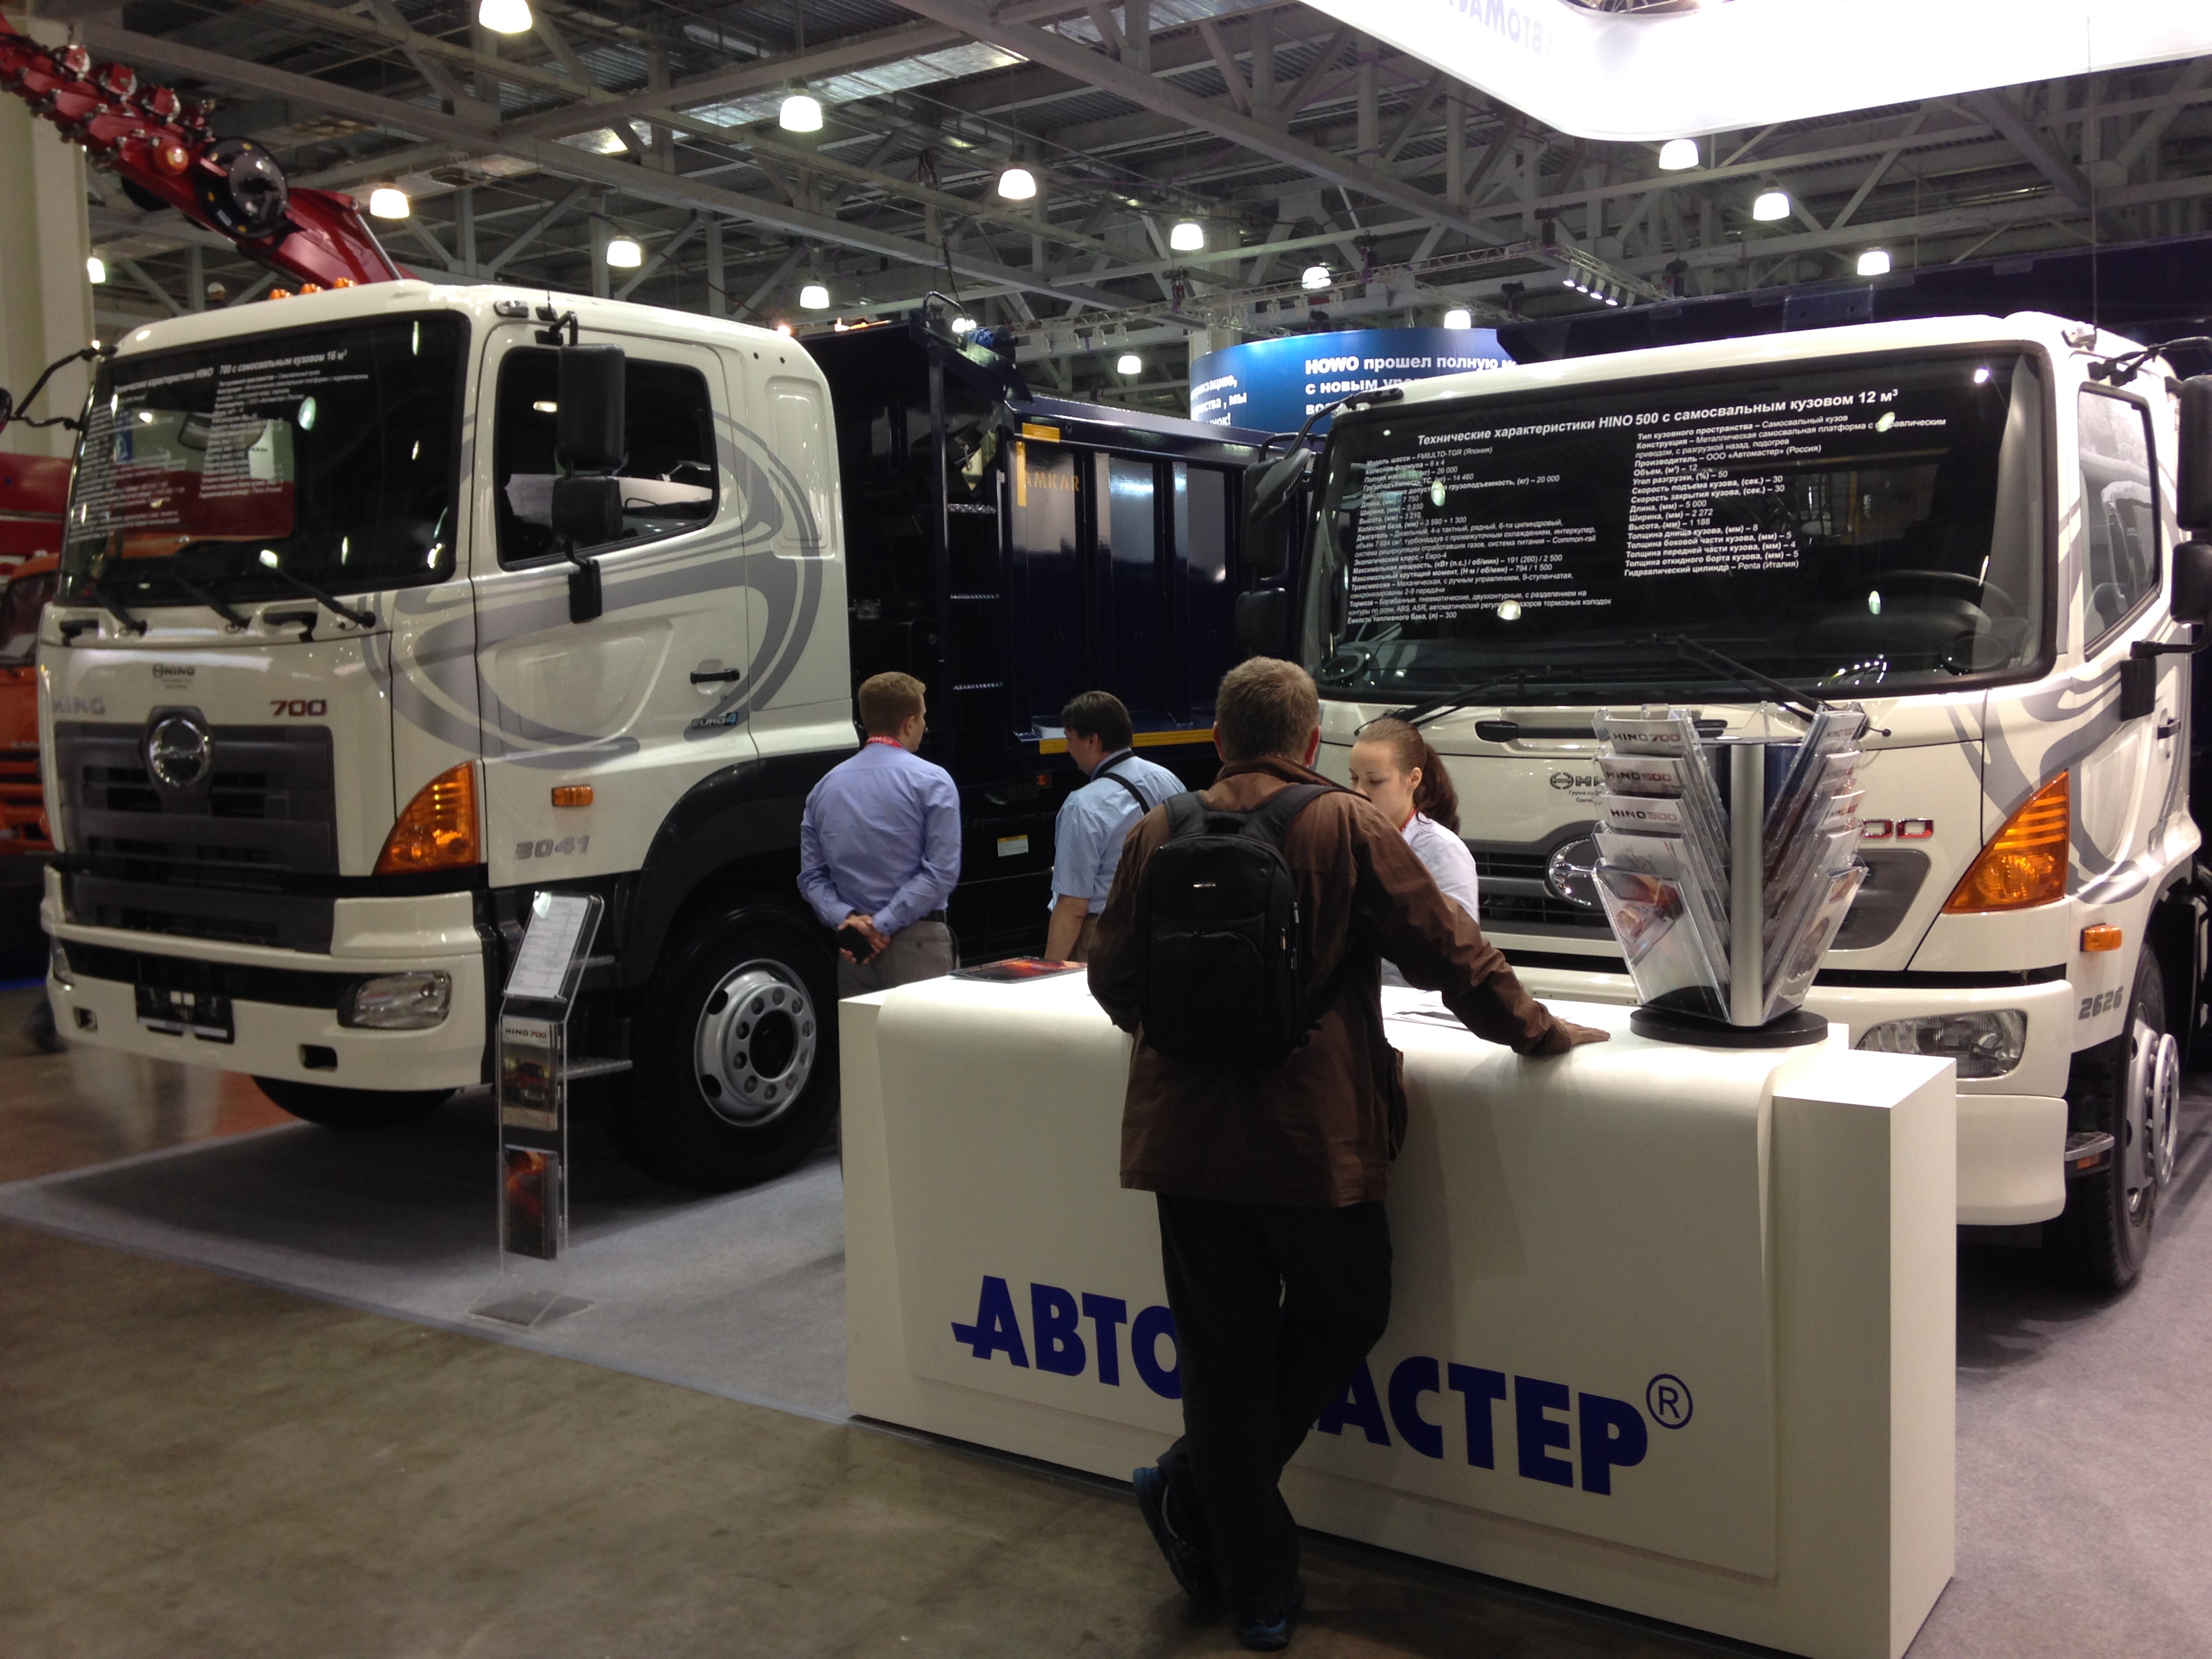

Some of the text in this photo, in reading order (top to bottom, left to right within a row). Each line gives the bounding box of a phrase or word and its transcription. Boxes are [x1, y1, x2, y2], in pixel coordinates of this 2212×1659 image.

[1305, 356, 1359, 374] HOWO
[1364, 356, 1431, 372] прошел
[1437, 358, 1498, 372] полную
[1305, 383, 1316, 394] с
[1320, 378, 1378, 394] новым
[1229, 392, 1247, 405] мы
[1418, 430, 1491, 447] Технические
[1494, 418, 1595, 438] характеристики
[1599, 415, 1633, 429] HINO
[1635, 413, 1659, 426] 500
[1662, 413, 1671, 423] с
[1674, 402, 1786, 421] самосвальным
[1790, 394, 1853, 412] кузовом
[1859, 390, 1876, 403] 12
[1654, 430, 1694, 440] кузовного
[1696, 423, 1753, 435] пространства
[1762, 416, 1823, 428] Самосвальный
[1826, 415, 1848, 424] кузов
[1637, 439, 1687, 449] Конструкция
[1696, 432, 1757, 443] Металлическая
[1758, 426, 1816, 438] самосвальная
[1818, 423, 1866, 434] платформа
[1682, 444, 1723, 454] разгрузкой
[1753, 438, 1790, 447] подогрев
[1635, 445, 1822, 468] Производитель ООО «Автомастер» (Россия)
[1632, 486, 1669, 495] Скорость
[1709, 480, 1739, 489] кузова,
[1742, 477, 1763, 485] (сек.)
[1633, 478, 1651, 486] Угол
[1652, 474, 1694, 483] разгрузки,
[1631, 495, 1668, 504] Скорость
[1671, 492, 1709, 500] закрытия
[1711, 489, 1741, 498] кузова,
[1744, 487, 1765, 495] (сек.)
[1630, 506, 1657, 514] Длина,
[1660, 503, 1677, 511] (мм)
[1630, 514, 1663, 522] Ширина,
[1665, 511, 1683, 520] (мм)
[1628, 532, 1662, 540] Толщина
[1694, 527, 1723, 535] кузова,
[1725, 525, 1744, 534] (мм)
[1663, 520, 1680, 529] (мм)
[1553, 535, 1596, 544] Common-rail
[1627, 541, 1662, 550] Толщина
[1664, 538, 1698, 546] боковой
[1725, 534, 1756, 543] кузова,
[1759, 532, 1777, 541] (мм)
[1425, 552, 1447, 561] Евро-4
[1626, 550, 1661, 558] Толщина
[1663, 547, 1702, 556] передней
[1729, 544, 1760, 552] кузова,
[1763, 541, 1781, 550] (мм)
[1520, 556, 1538, 564] (260)
[1625, 559, 1660, 568] Толщина
[1662, 556, 1704, 565] откидного
[1706, 554, 1729, 563] борта
[1732, 552, 1762, 562] кузова,
[1765, 550, 1784, 560] (мм)
[1624, 560, 1799, 577] Гидравлический цилиндр Penta (Италия)
[270, 699, 328, 717] 700
[1613, 733, 1648, 741] HINO
[1606, 771, 1641, 781] HINO
[1611, 809, 1646, 819] HINO
[514, 835, 590, 860] 3041
[2078, 985, 2124, 1021] 2626
[506, 1027, 547, 1039] HINO 700
[950, 1274, 1648, 1496] АВТОАСТЕР
